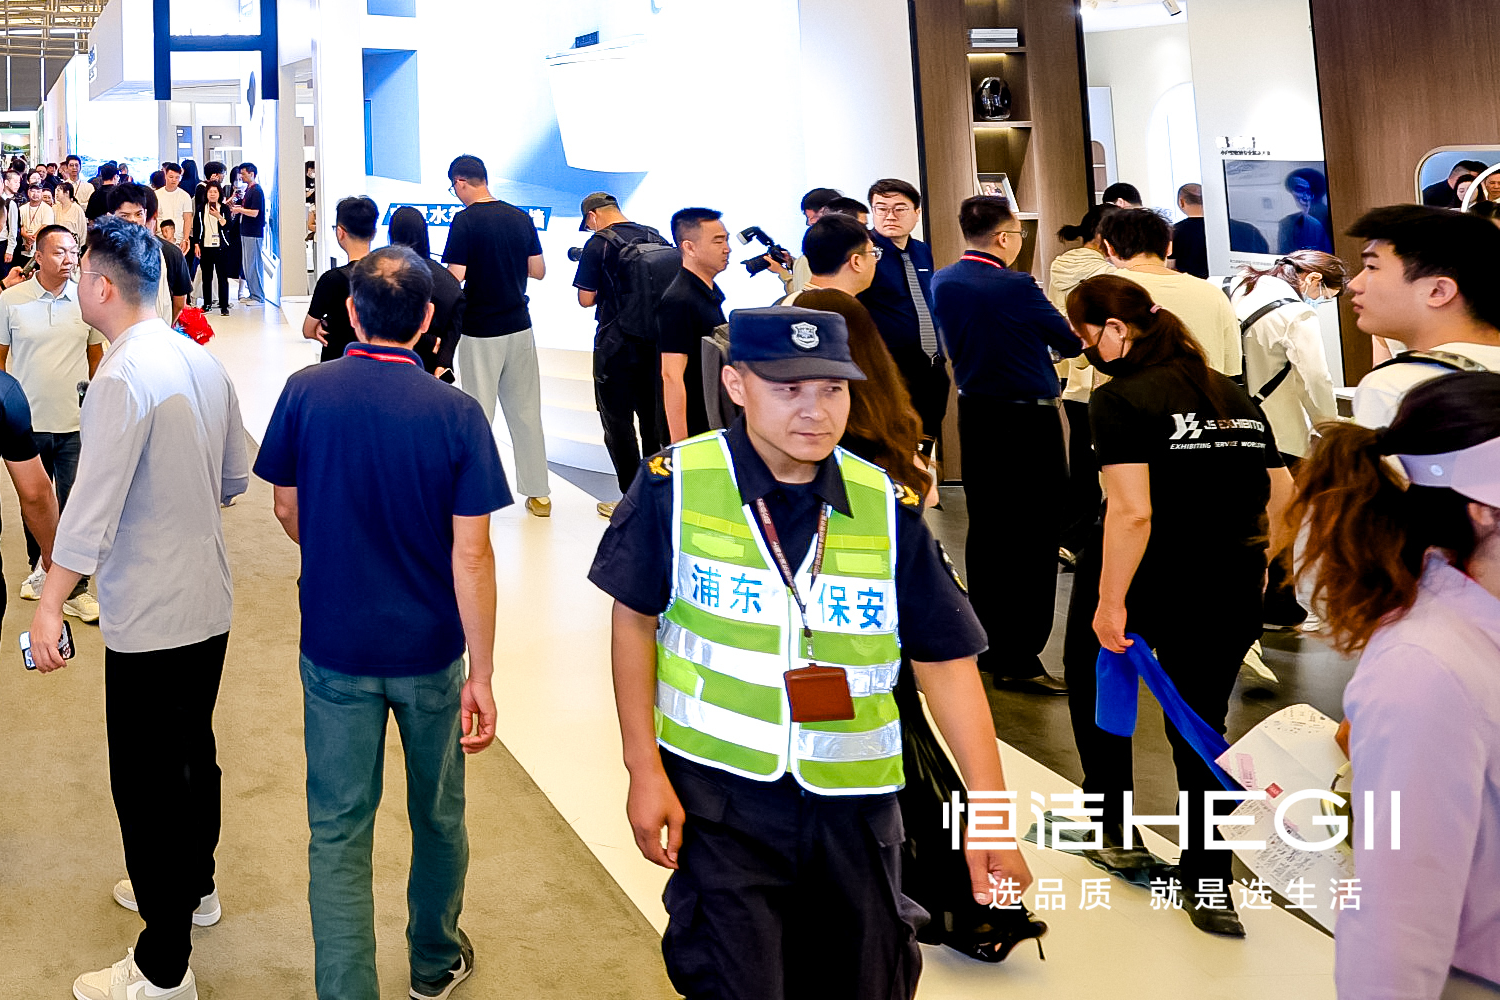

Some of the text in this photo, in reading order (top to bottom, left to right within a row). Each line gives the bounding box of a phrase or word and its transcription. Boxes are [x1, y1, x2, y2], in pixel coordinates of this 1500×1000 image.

[1169, 442, 1212, 450] EXHIBITING
[691, 562, 885, 630] 浦东 保安
